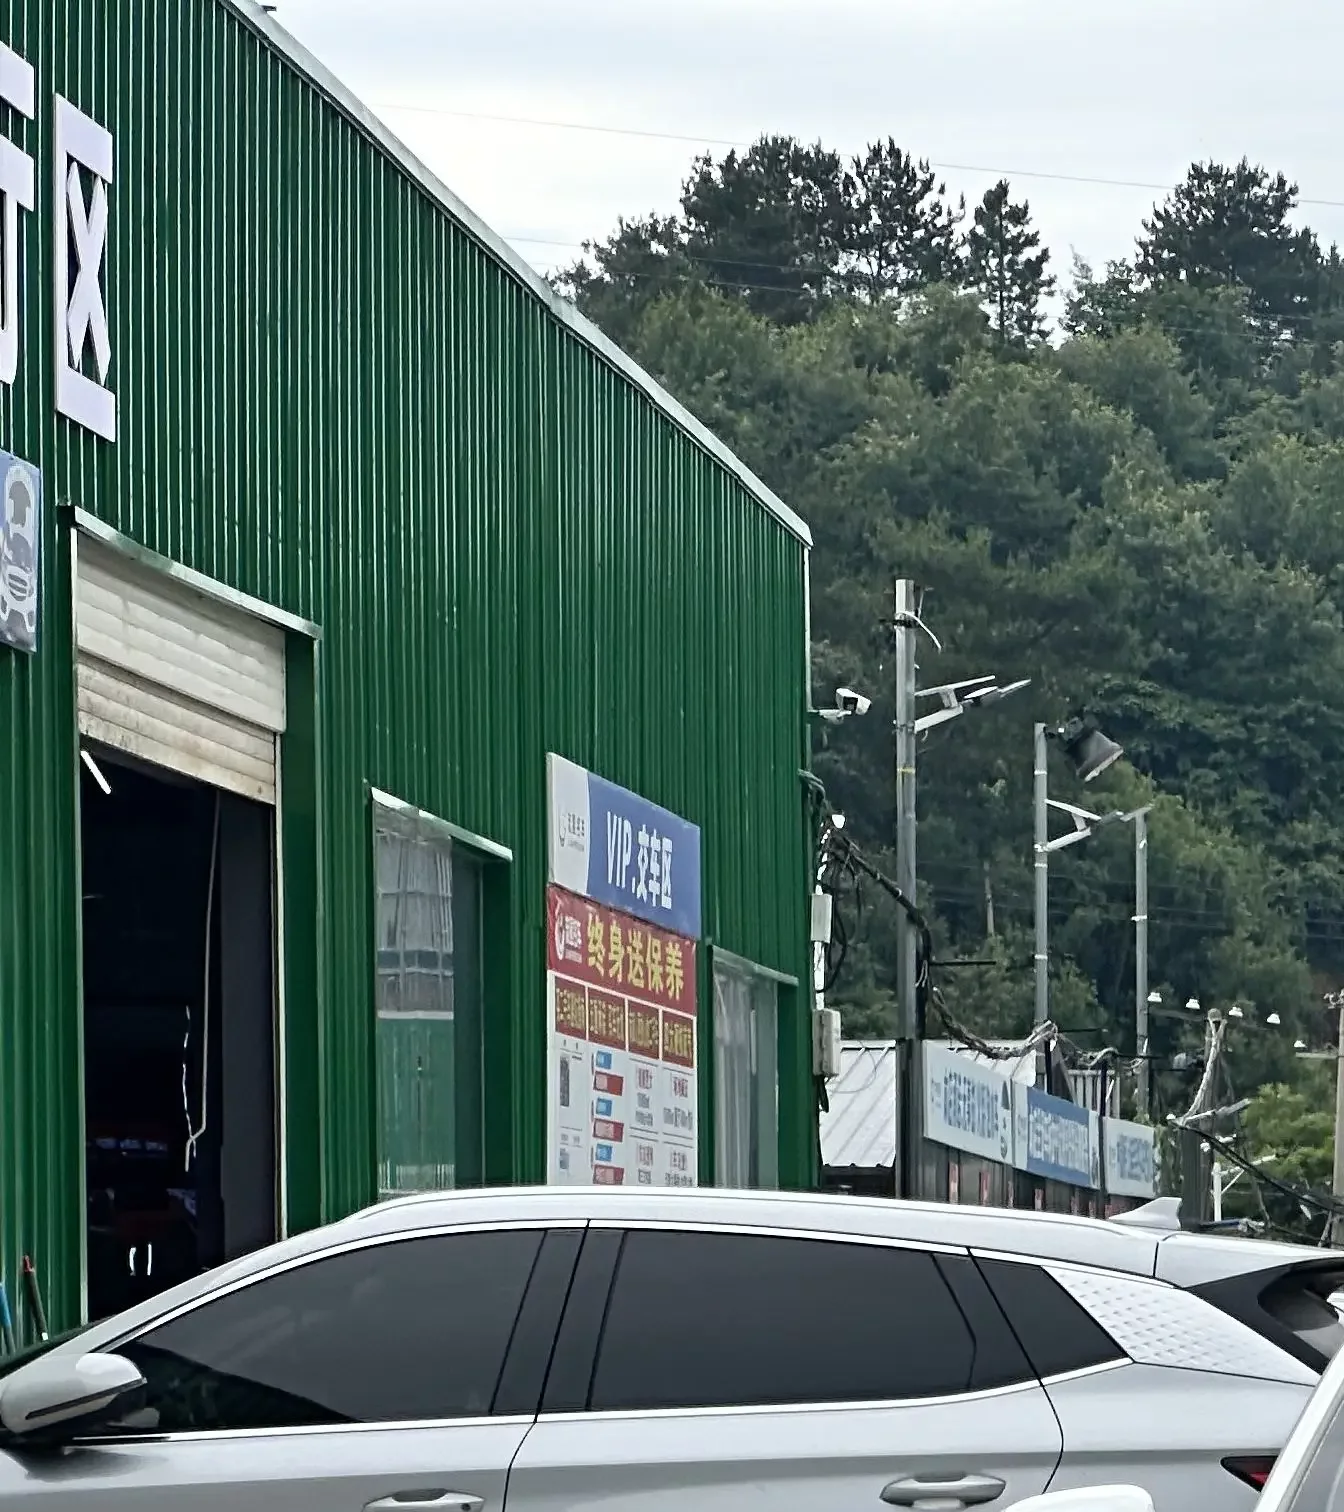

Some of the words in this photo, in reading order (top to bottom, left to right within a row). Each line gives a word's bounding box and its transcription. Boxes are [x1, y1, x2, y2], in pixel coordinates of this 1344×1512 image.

[586, 911, 685, 1001] 终身送保养
